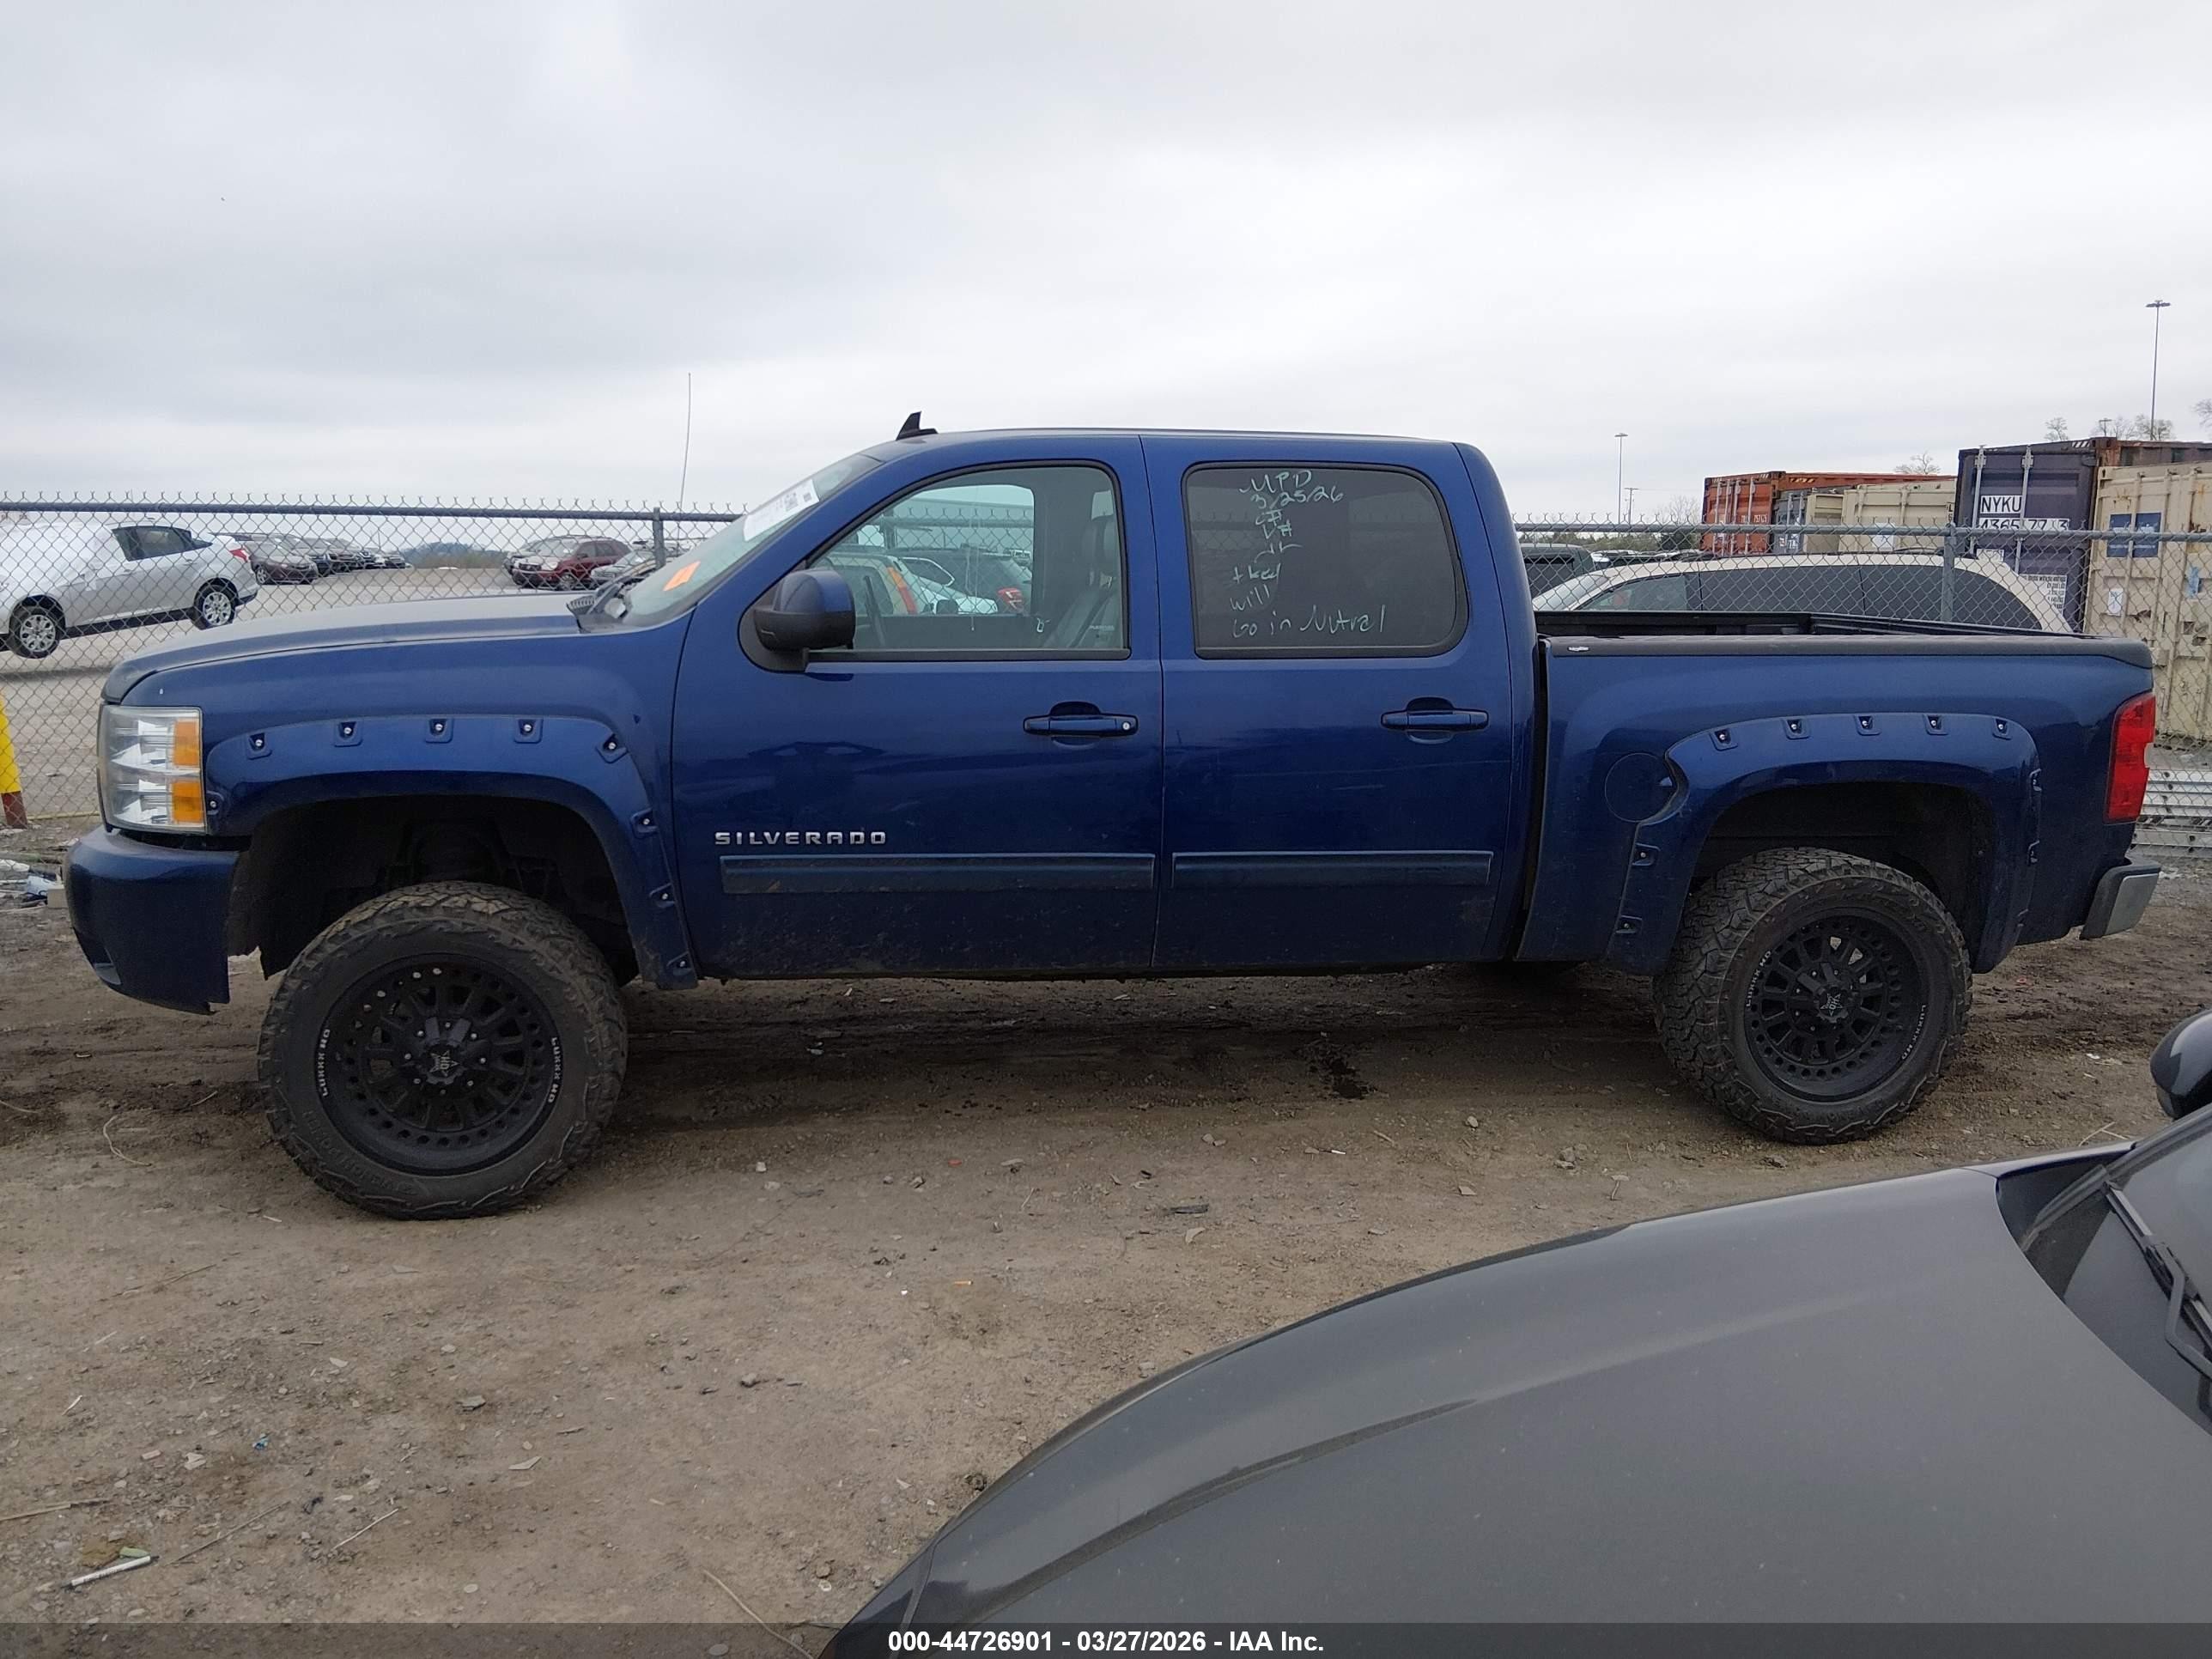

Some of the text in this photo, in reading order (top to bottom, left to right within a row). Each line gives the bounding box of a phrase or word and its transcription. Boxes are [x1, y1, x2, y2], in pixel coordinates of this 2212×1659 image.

[1250, 485, 1344, 509] 3/25/26
[1980, 496, 2022, 513] NYKU
[714, 831, 887, 845] SILVERADO
